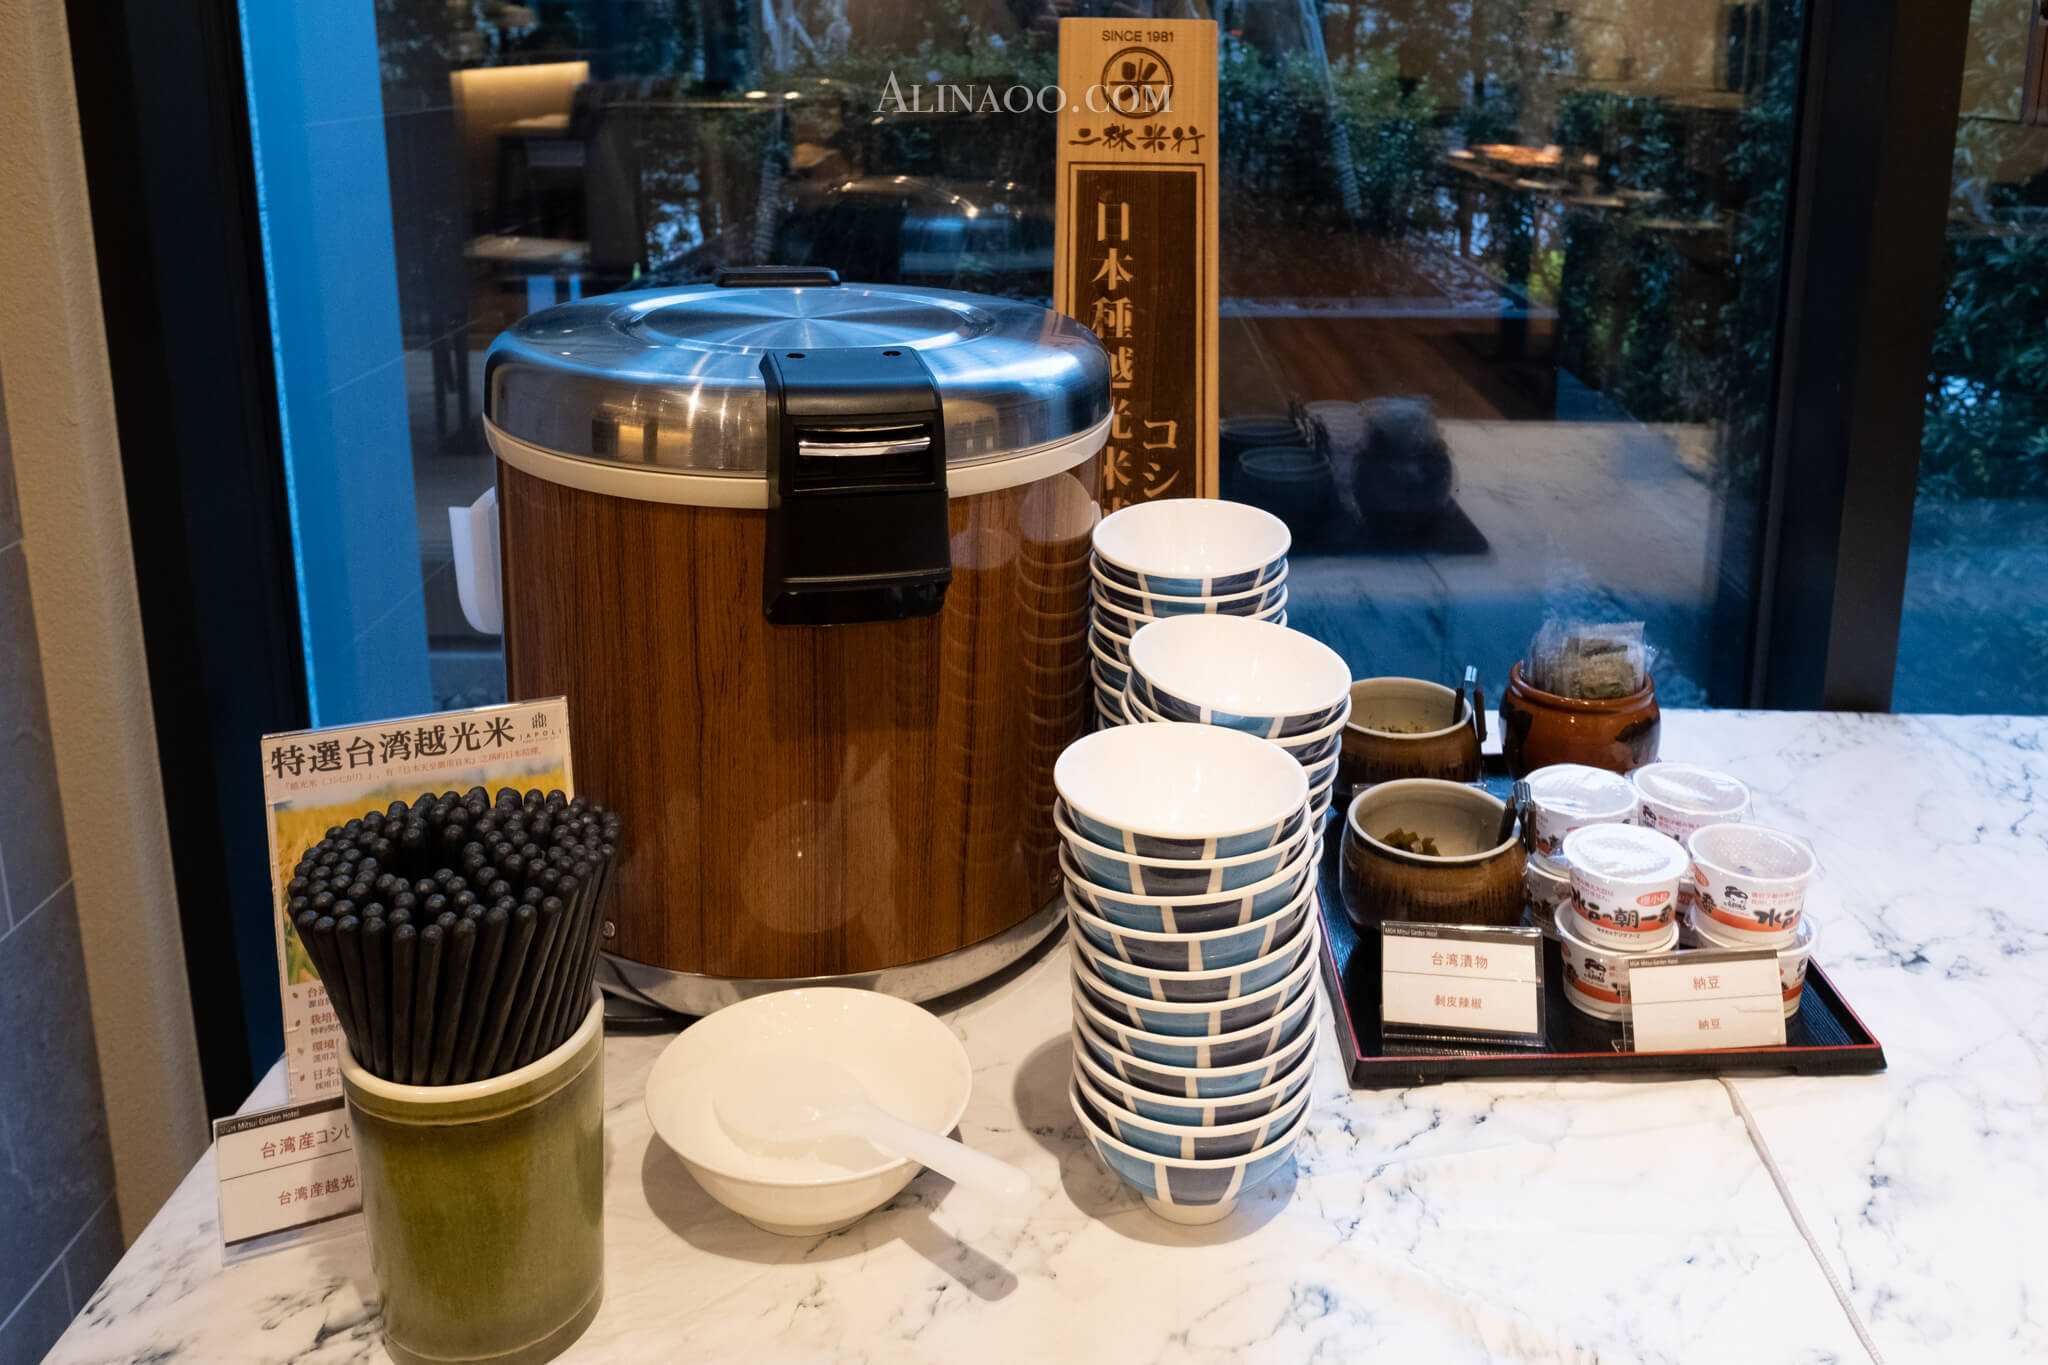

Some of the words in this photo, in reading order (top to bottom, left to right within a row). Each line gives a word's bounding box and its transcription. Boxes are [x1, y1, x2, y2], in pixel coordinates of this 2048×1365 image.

[1102, 30, 1143, 42] SINCE
[1147, 31, 1174, 43] 1981
[271, 716, 516, 779] 特選台湾越光米
[1693, 975, 1720, 991] 納豆
[1698, 1016, 1720, 1030] 納豆
[237, 1118, 257, 1131] Mitsui
[258, 1114, 281, 1126] Garden
[282, 1109, 300, 1120] Hotel
